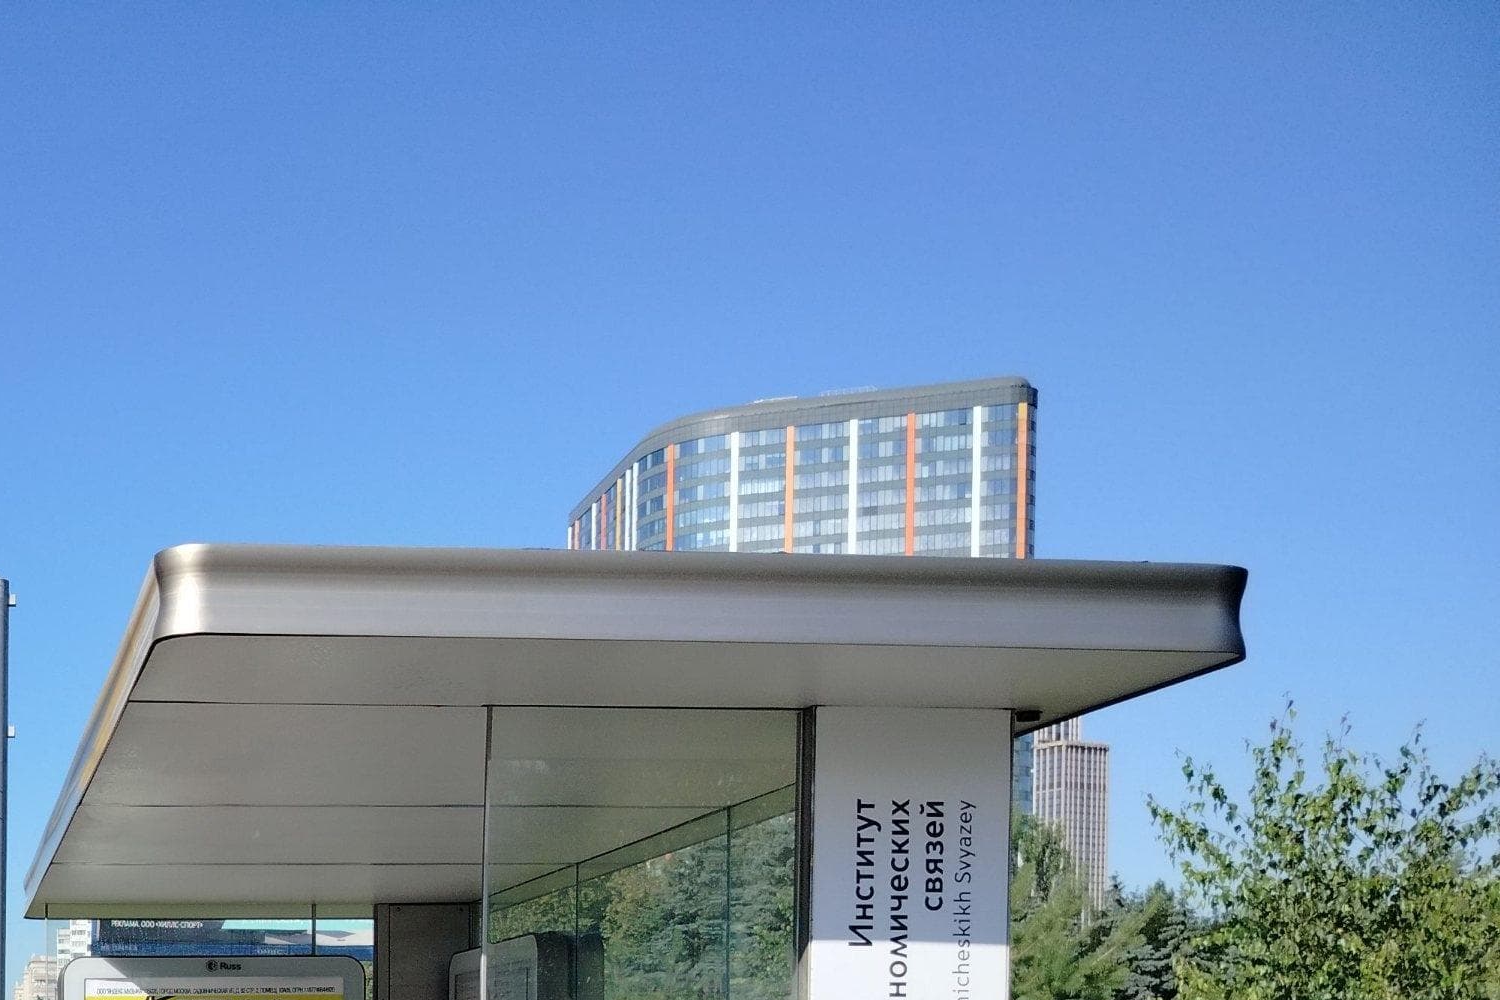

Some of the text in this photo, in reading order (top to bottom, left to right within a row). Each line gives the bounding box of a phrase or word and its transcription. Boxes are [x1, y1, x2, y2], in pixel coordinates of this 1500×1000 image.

[848, 799, 882, 946] Институт
[919, 801, 944, 911] связей
[954, 800, 977, 884] Svyazey
[220, 962, 241, 970] Russ
